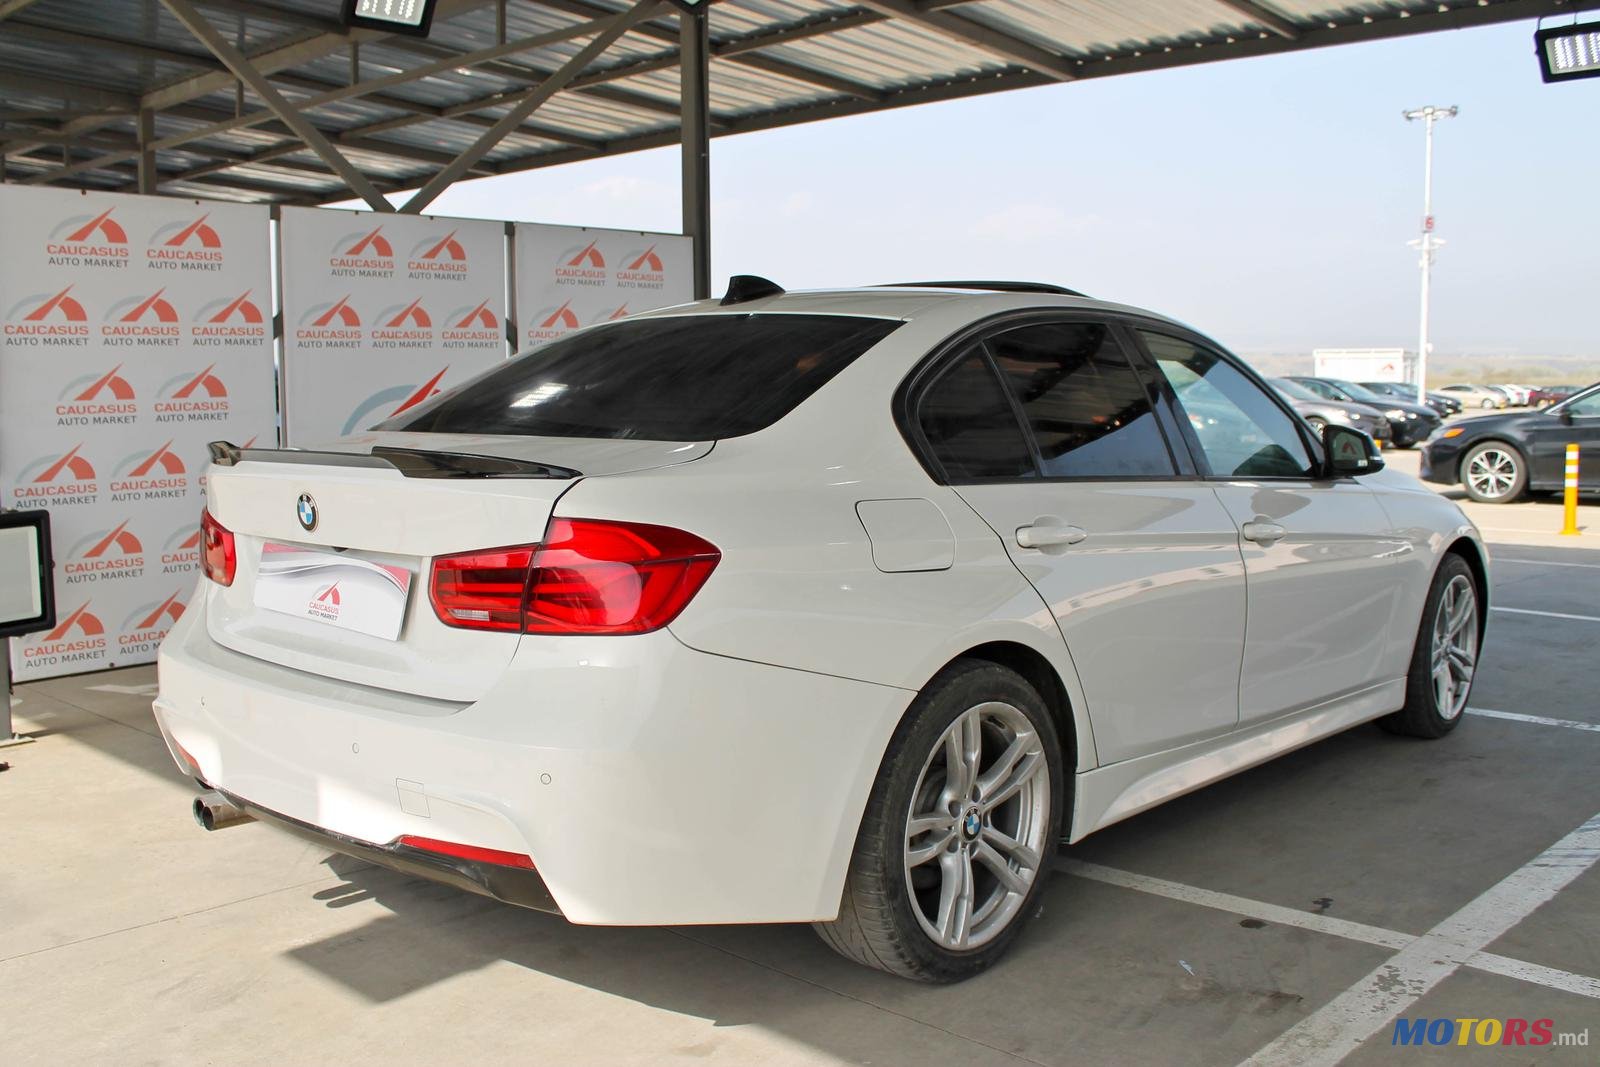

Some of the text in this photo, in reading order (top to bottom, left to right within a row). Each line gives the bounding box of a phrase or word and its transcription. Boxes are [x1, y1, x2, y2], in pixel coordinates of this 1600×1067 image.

[47, 245, 129, 257] CAUCASUS
[146, 249, 222, 262] CAUCASUS
[48, 257, 129, 268] AUTO MARKET
[148, 261, 222, 271] AUTO MARKET
[330, 258, 394, 269] CAUCASUS
[408, 261, 467, 272] CAUCASUS
[331, 269, 394, 278] AUTO MARKET
[408, 272, 466, 280] AUTO MARKET
[555, 268, 605, 278] CAUCASUS
[617, 272, 664, 282] CAUCASUS
[4, 325, 89, 336] CAUCASUS
[102, 326, 180, 336] CAUCASUS
[192, 327, 264, 336] CAUCASUS
[296, 330, 361, 339] CAUCASUS
[371, 330, 432, 339] CAUCASUS
[442, 331, 499, 340] CAUCASUS
[528, 330, 566, 339] CAUCA
[6, 337, 88, 346] AUTO MARKET
[103, 338, 180, 346] AUTO MARKET
[193, 338, 264, 346] AUTO MARKET
[56, 404, 137, 415] CAUCASUS
[154, 402, 228, 412] CAUCASUS
[57, 416, 137, 426] AUTO MARKET
[155, 412, 229, 423] AUTO MARKET
[110, 478, 187, 492] CAUCASUS
[14, 483, 97, 498] CAUCASUS
[111, 490, 187, 501] AUTO MARKET
[16, 496, 97, 509] AUTO MARKET
[162, 552, 199, 564] CAUC
[64, 557, 144, 574] CAUCASUS
[163, 564, 191, 573] AUTO
[66, 569, 144, 584] AUTO MARKET
[118, 630, 169, 645] CAUCA
[24, 638, 106, 658] CAUCASUS
[120, 644, 149, 654] AUTO
[25, 649, 106, 668] AUTO MARKET
